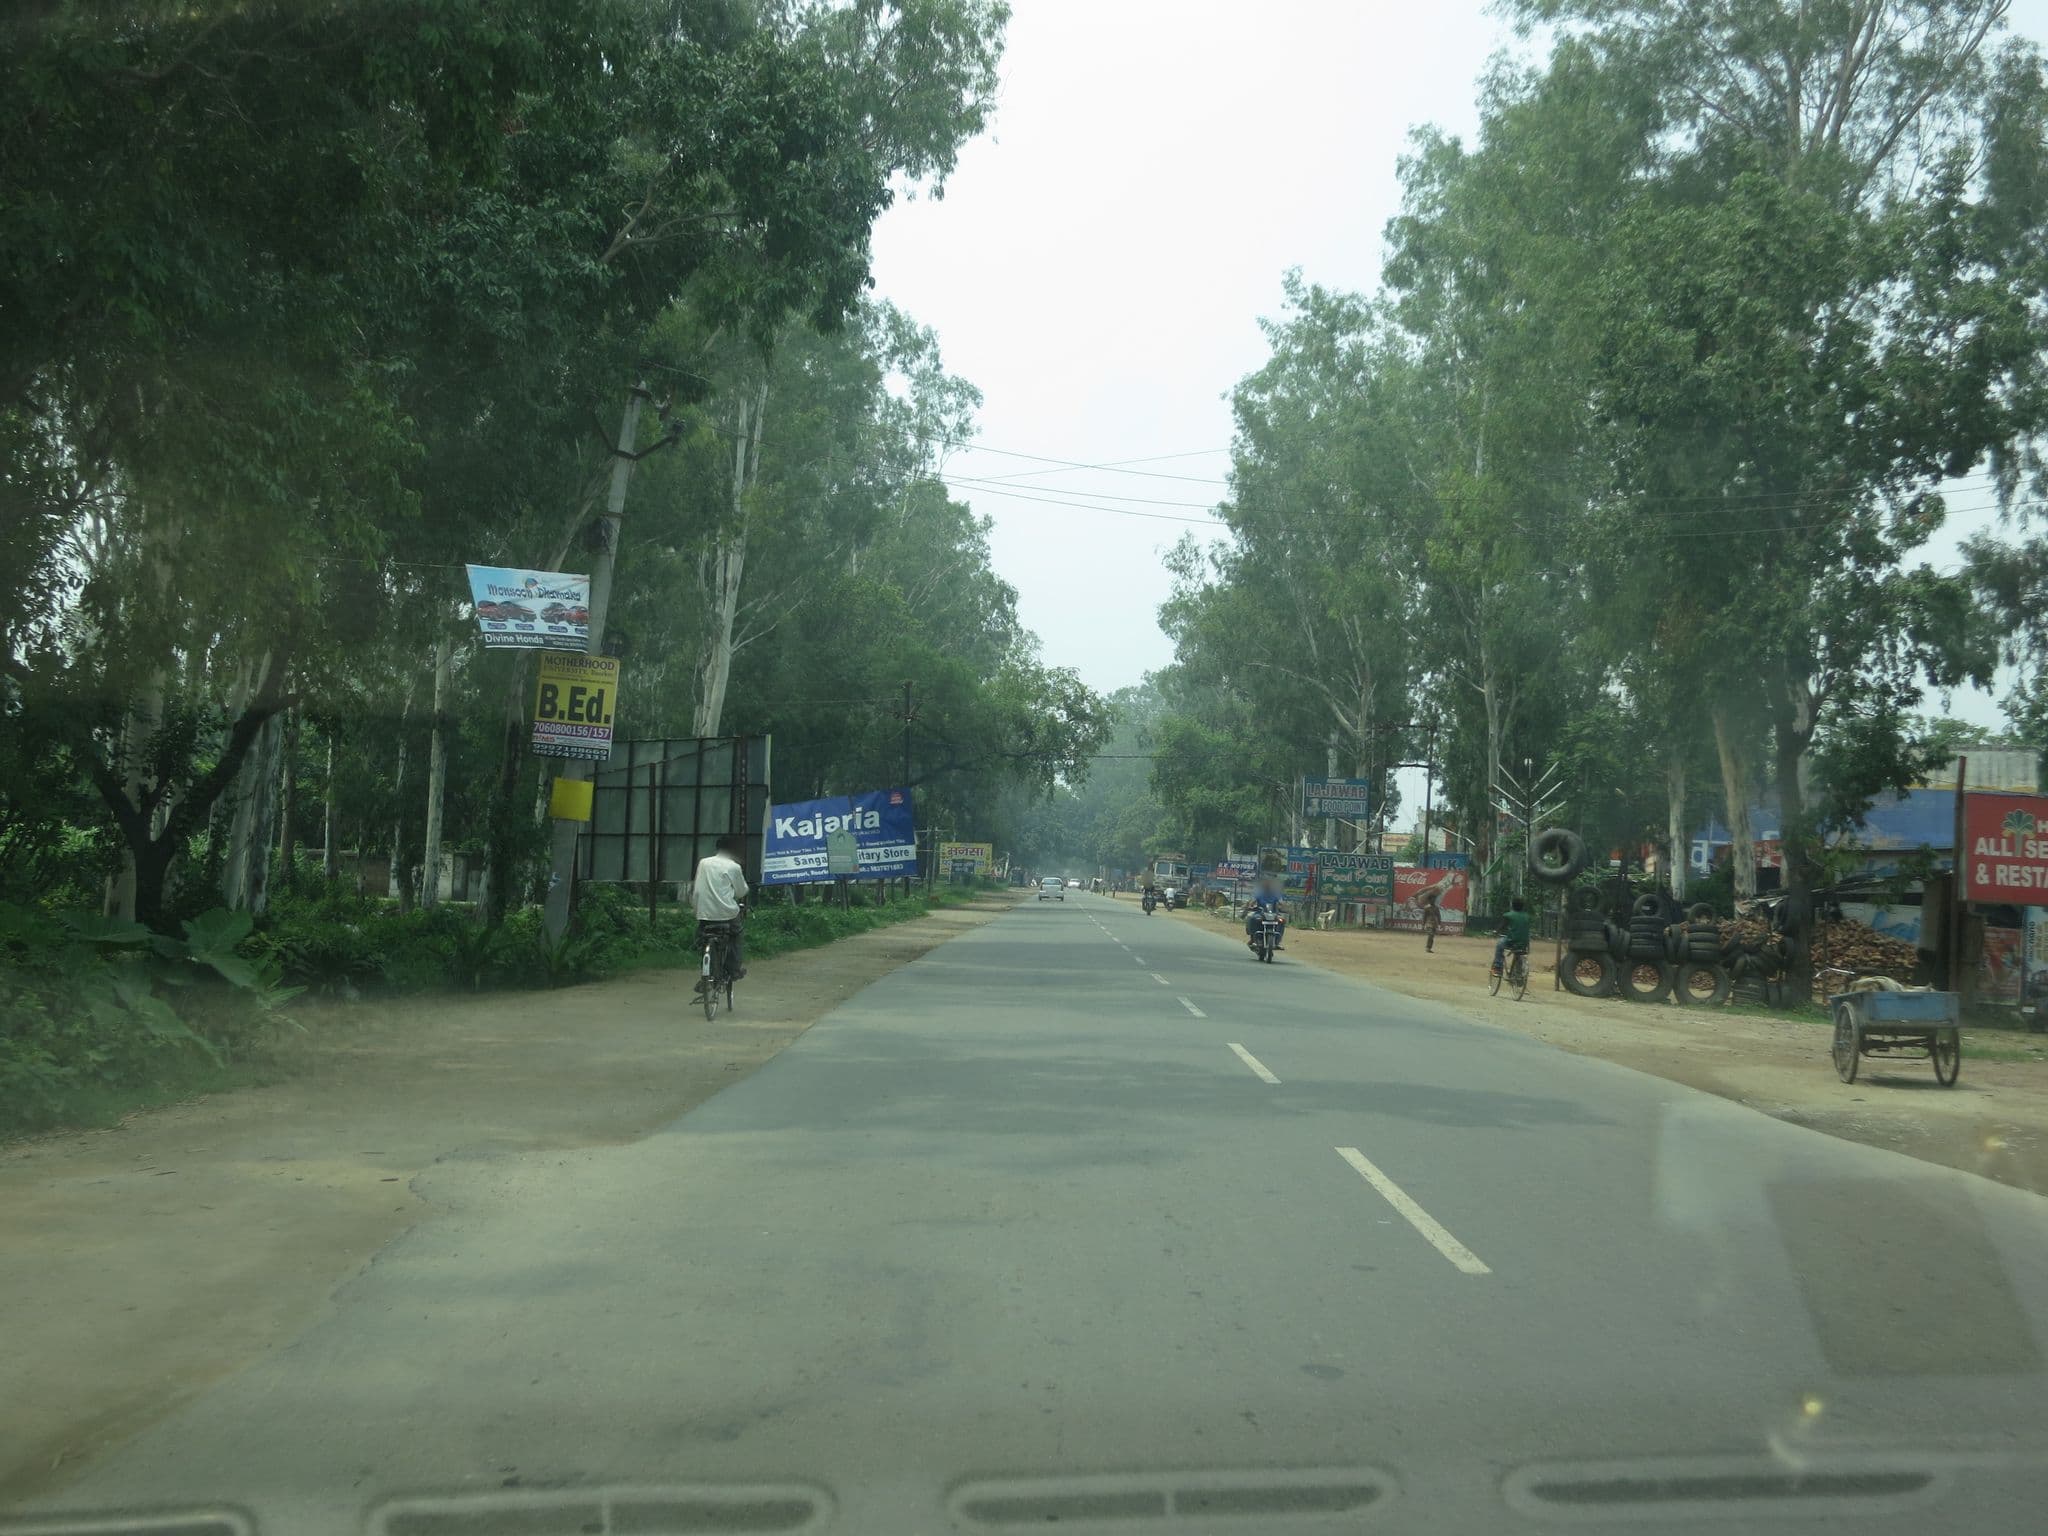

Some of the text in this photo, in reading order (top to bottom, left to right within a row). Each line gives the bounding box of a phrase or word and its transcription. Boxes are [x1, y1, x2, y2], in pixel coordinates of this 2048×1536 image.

[484, 634, 514, 643] Divine
[515, 635, 544, 644] Honda
[544, 656, 615, 670] MOTHERHOOD
[538, 683, 611, 724] B.Ed.
[533, 722, 609, 738] 7060800156/157
[1306, 783, 1368, 799] LAJAWAB
[1322, 799, 1366, 814] FOOD POINT
[775, 806, 880, 840] Kajaria
[1975, 837, 2013, 856] ALL
[858, 850, 881, 861] itary
[883, 849, 909, 859] Store
[1321, 855, 1390, 870] LAJAWAB
[1975, 863, 1990, 885] &
